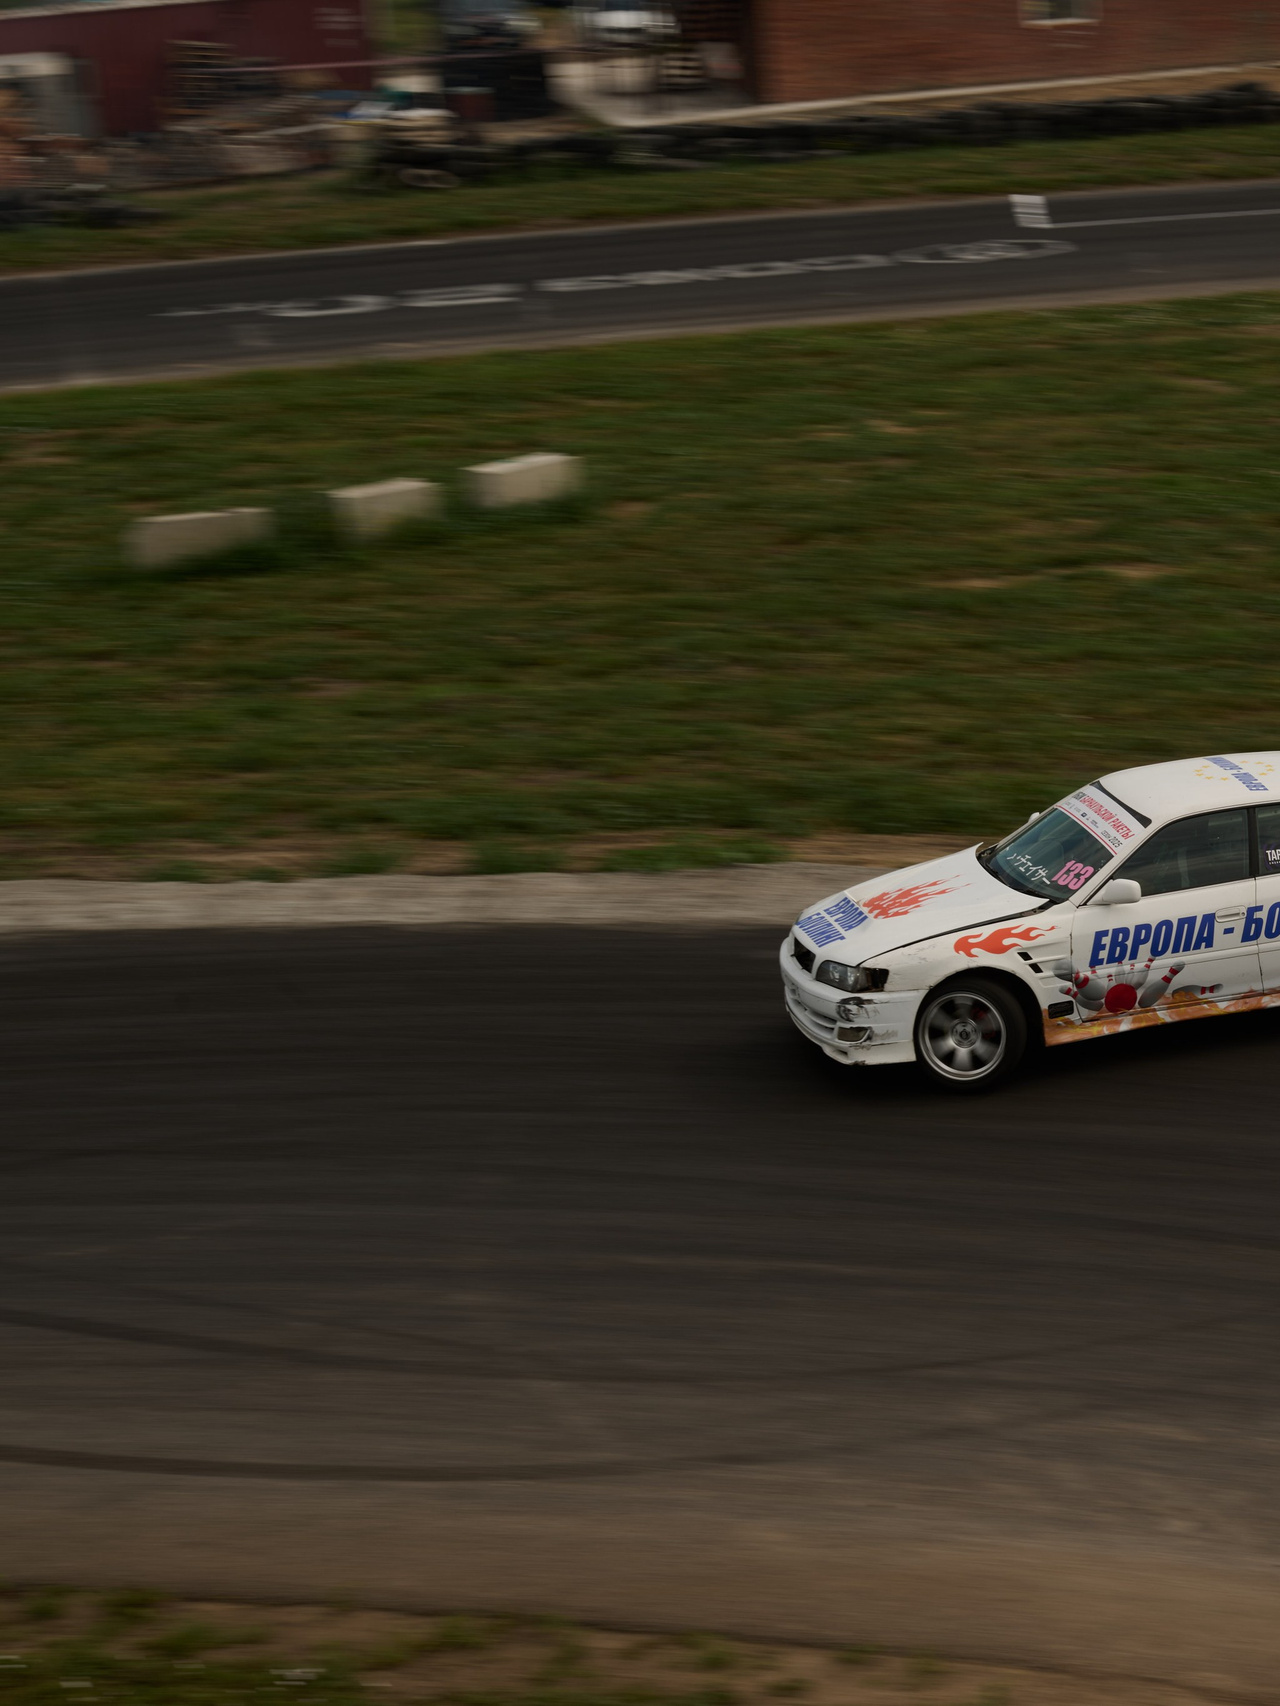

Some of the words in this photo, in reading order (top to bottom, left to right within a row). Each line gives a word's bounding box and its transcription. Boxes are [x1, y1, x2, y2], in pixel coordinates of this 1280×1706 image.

[1108, 818, 1135, 840] РАКЕТЫ
[1051, 860, 1095, 890] 133
[823, 896, 868, 932] ЕВРОПА
[1089, 912, 1216, 968] ЕВРОПА
